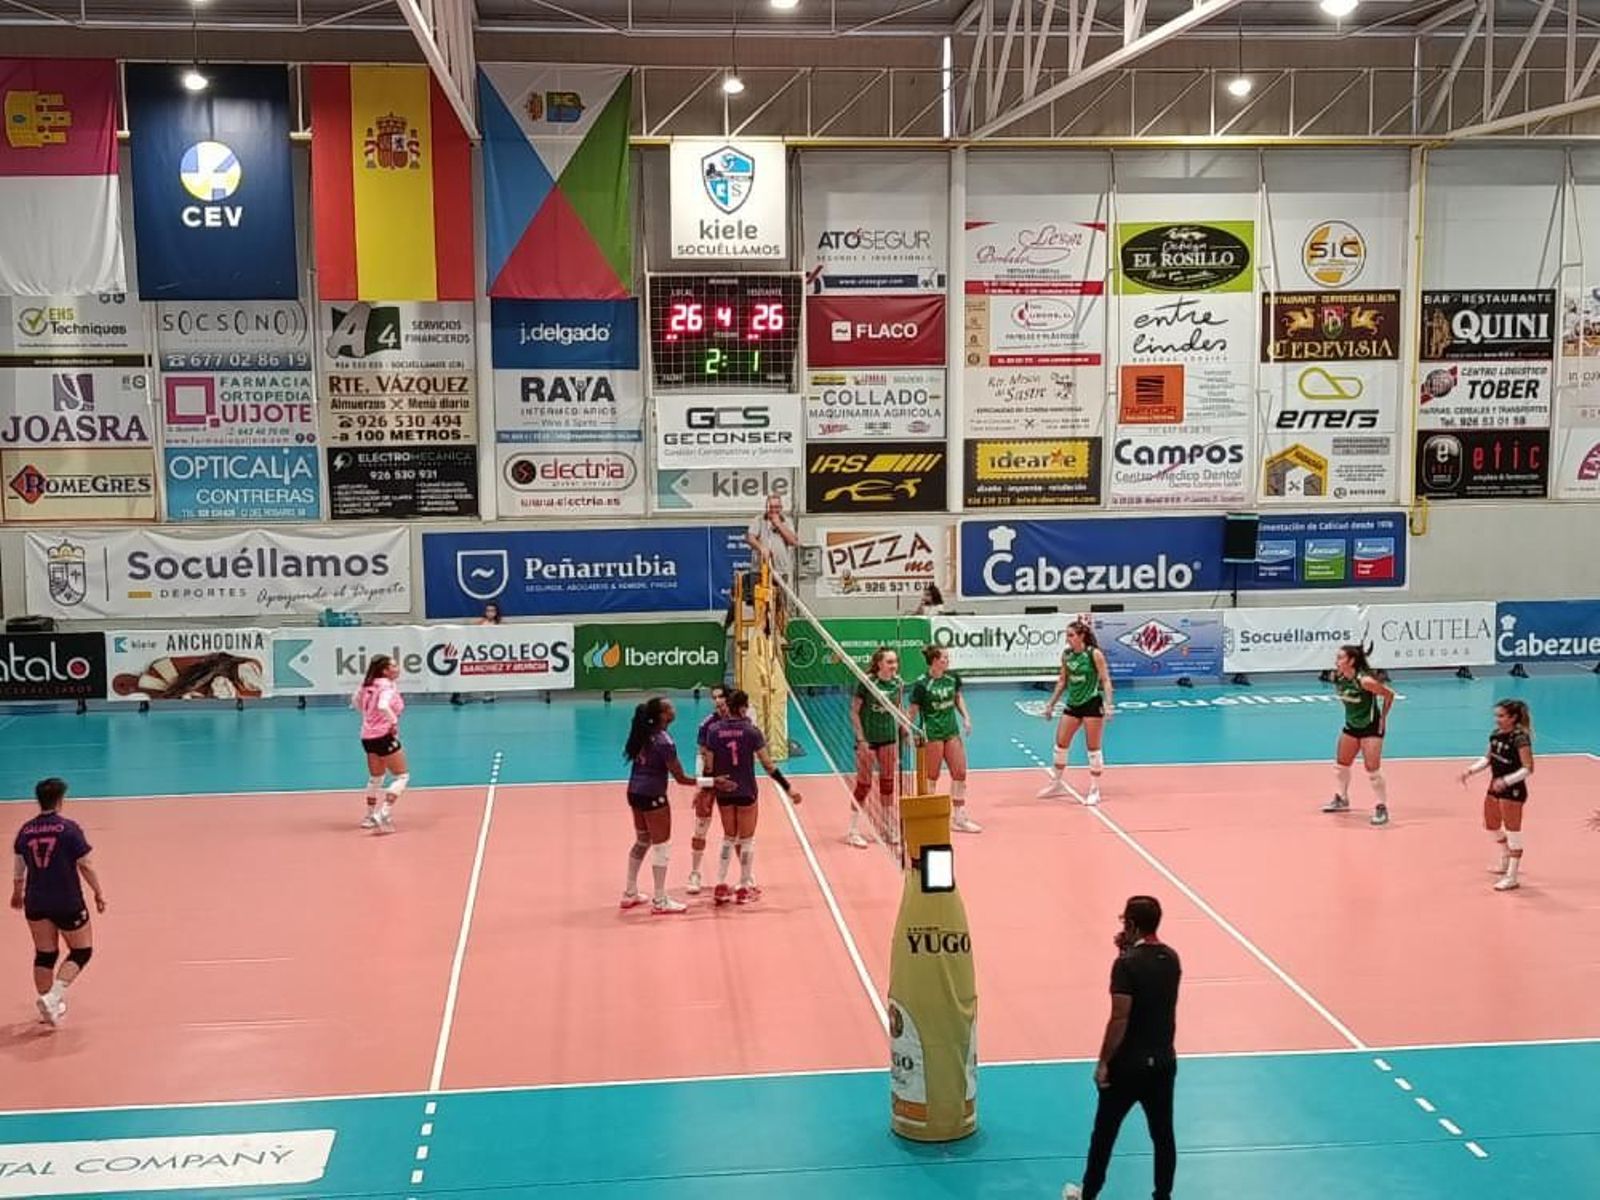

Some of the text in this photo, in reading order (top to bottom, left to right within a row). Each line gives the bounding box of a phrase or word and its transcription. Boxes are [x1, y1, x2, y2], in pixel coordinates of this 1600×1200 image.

[182, 206, 243, 229] CEV
[700, 218, 758, 240] kiele
[677, 243, 781, 255] SOCUÉLLAMOS
[1133, 251, 1234, 268] EL ROSILLO
[1309, 241, 1359, 258] SIC
[1424, 294, 1450, 305] BAR
[1461, 293, 1551, 304] RESTAURANTE
[671, 304, 702, 331] 26
[717, 306, 732, 327] 4
[752, 304, 783, 330] 26
[1133, 297, 1229, 329] entre
[50, 321, 127, 337] Techniques
[411, 320, 461, 330] SERVICIOS
[520, 323, 609, 345] j.delgado
[856, 321, 918, 338] FLACO
[1452, 309, 1549, 344] QUINI
[1133, 328, 1227, 354] lindes
[190, 353, 308, 367] 677 02 86 19
[220, 376, 310, 388] FARMACIA
[1461, 367, 1498, 376] CENTRO
[329, 373, 469, 395] RTE. VÁZQUEZ
[521, 376, 615, 403] RAYA
[1467, 379, 1540, 400] TOBER
[220, 391, 311, 402] ORTOPEDIA
[330, 398, 386, 410] Almuerzos
[440, 397, 470, 409] diario
[823, 389, 928, 406] COLLADO
[357, 414, 461, 428] 926 530 494
[686, 406, 771, 429] GCS
[809, 408, 881, 419] MAQUINARIA
[1, 414, 149, 442] JOASRA
[356, 430, 385, 441] 100
[664, 431, 792, 445] GECONSER
[1114, 438, 1244, 465] Campos
[1473, 440, 1540, 470] etic
[540, 457, 625, 479] electria
[811, 454, 868, 474] IRS
[1203, 468, 1241, 480] Dental
[369, 471, 391, 481] 926
[712, 471, 789, 498] kiele
[195, 487, 315, 505] CONTRERAS
[1258, 521, 1305, 532] imentación
[127, 546, 389, 581] Socuéllamos
[827, 531, 933, 575] PIZZA
[524, 554, 677, 580] Peñarrubia
[904, 561, 935, 572] me
[983, 553, 1194, 594] Cabezuelo
[159, 586, 248, 599] DEPORTES
[865, 581, 886, 592] 926
[933, 623, 1067, 652] QualitySpor
[1240, 627, 1351, 644] Socuéllamos
[1381, 618, 1492, 642] CAUTELA
[165, 632, 265, 652] ANCHODINA
[335, 645, 423, 676] kile
[426, 641, 570, 676] GASOLEOS
[625, 646, 719, 667] Iberdrola
[1394, 648, 1471, 658] BODEGAS
[727, 740, 739, 766] 1
[27, 836, 57, 868] 17
[908, 932, 972, 954] YUGO
[75, 1146, 295, 1174] COMPANY
